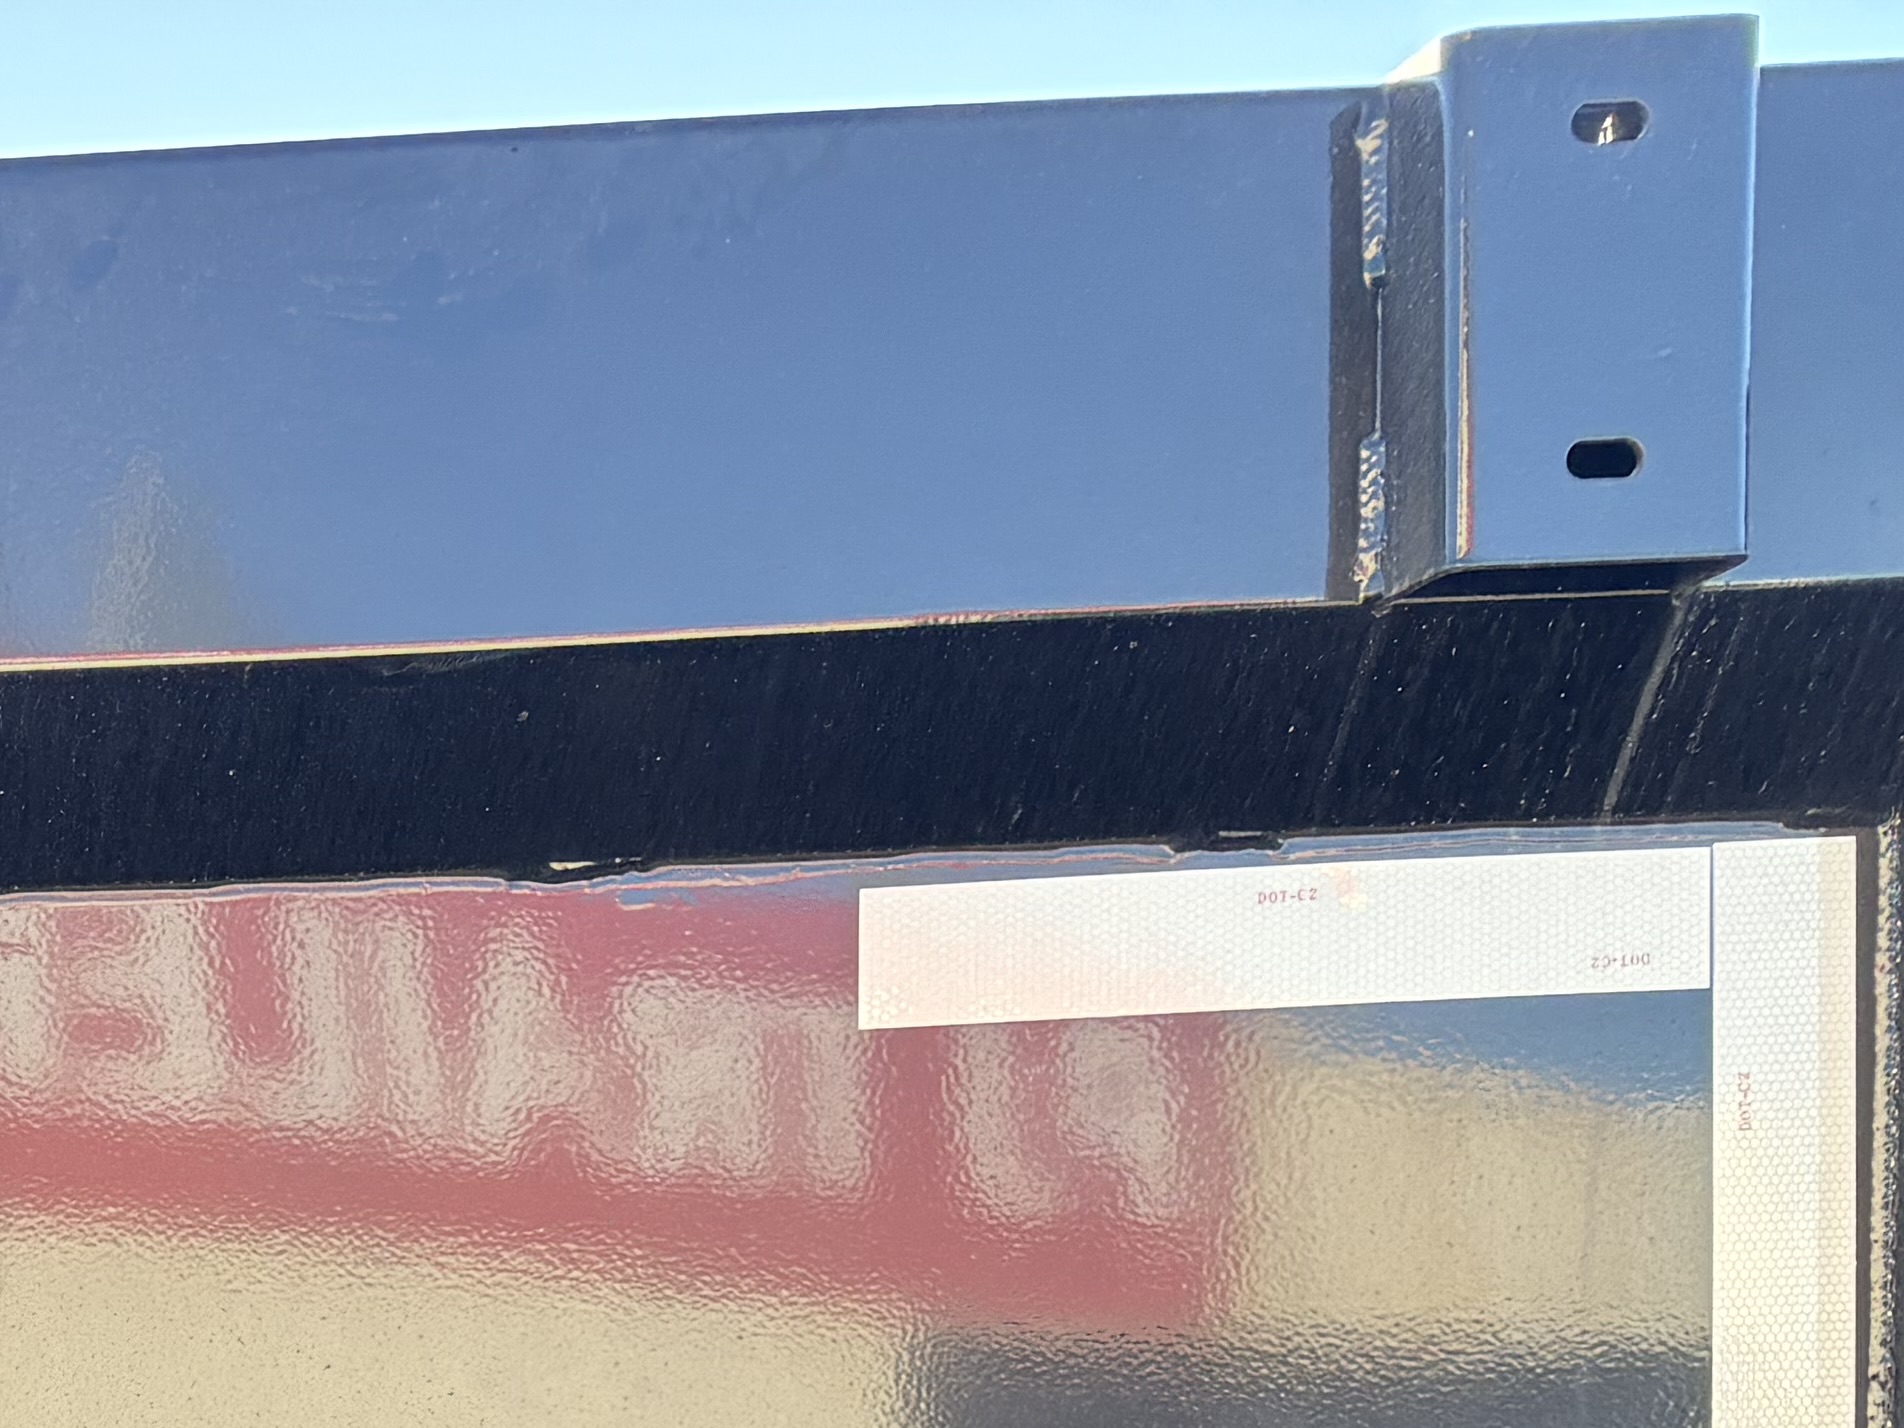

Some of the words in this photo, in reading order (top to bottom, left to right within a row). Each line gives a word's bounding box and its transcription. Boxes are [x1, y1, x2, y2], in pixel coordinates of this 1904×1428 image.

[1258, 888, 1318, 904] DOT-C2
[1591, 953, 1651, 969] DOT-C2
[1737, 1072, 1753, 1131] DOT-C2
